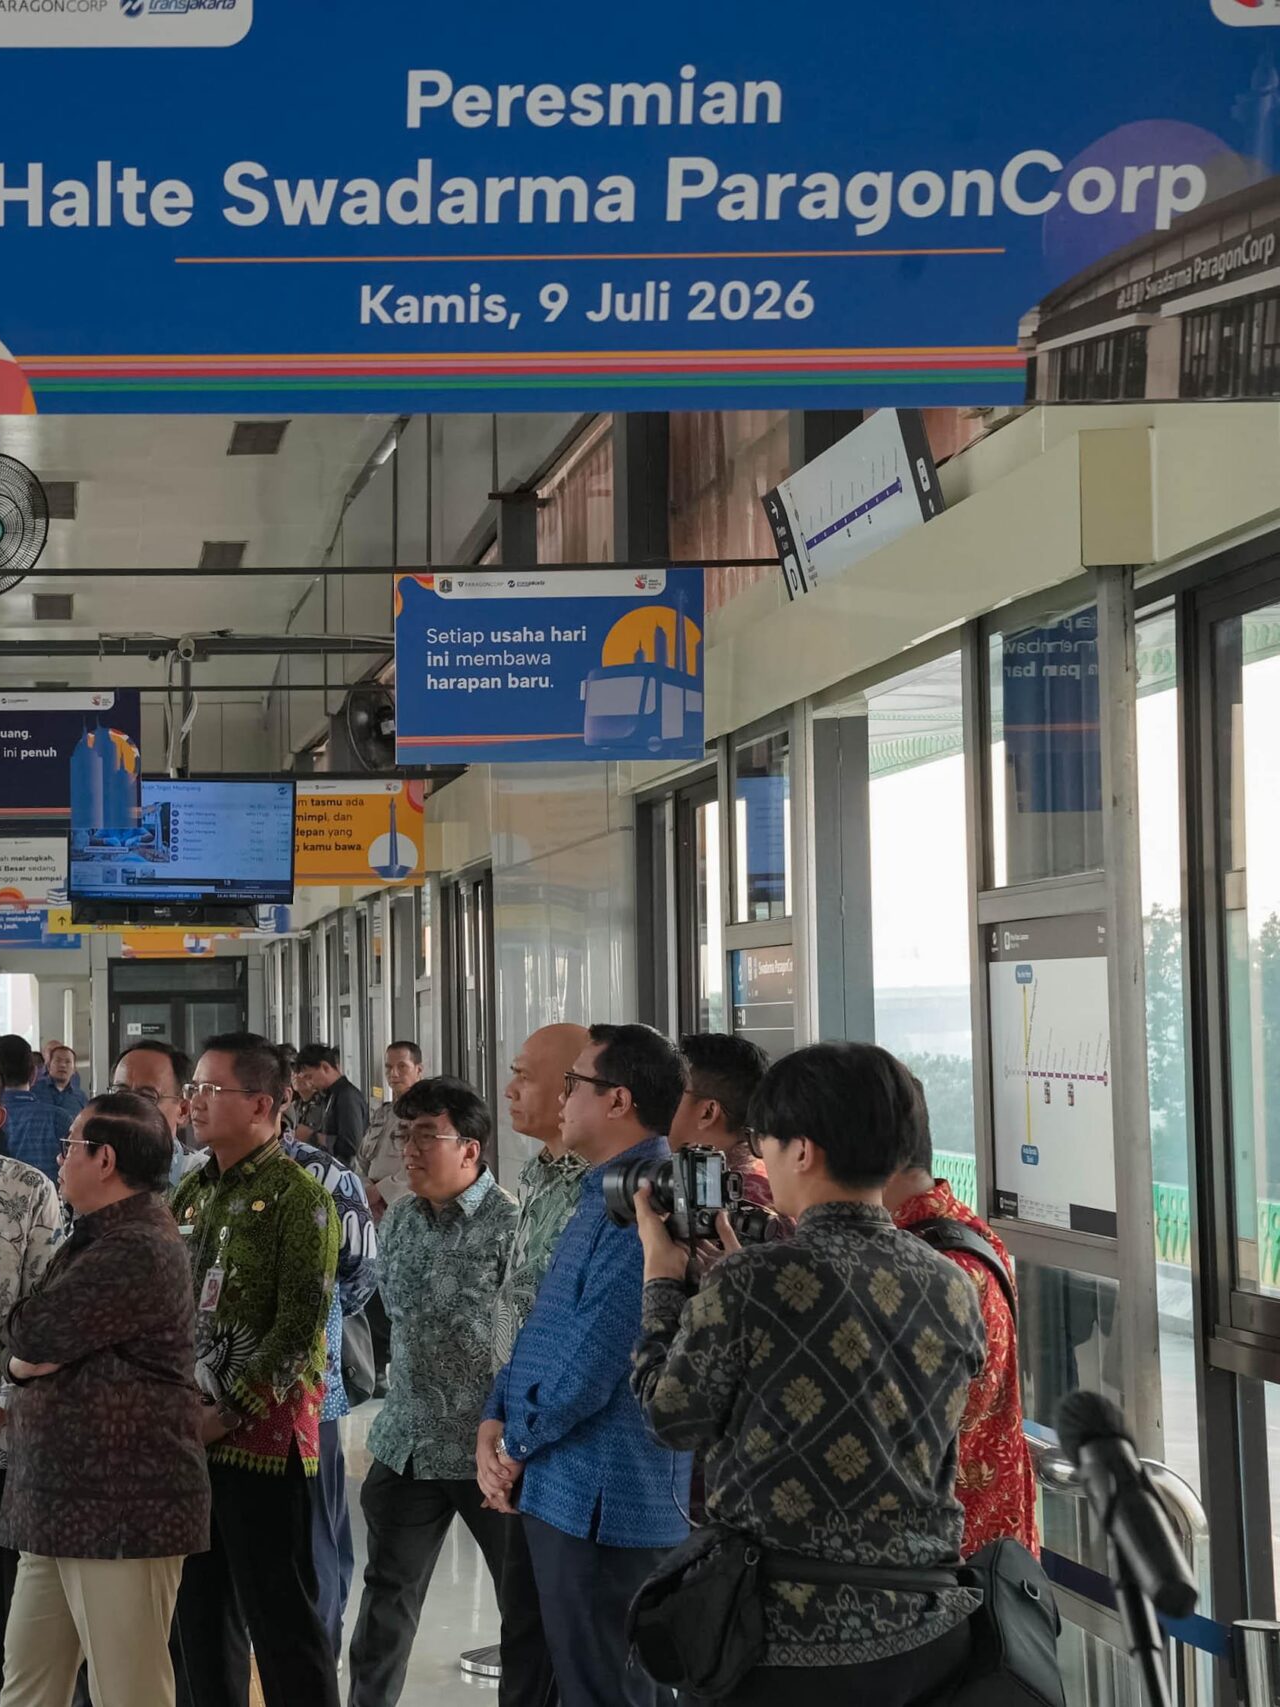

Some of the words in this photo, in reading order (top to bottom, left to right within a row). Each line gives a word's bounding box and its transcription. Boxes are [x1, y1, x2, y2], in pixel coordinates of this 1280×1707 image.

[406, 64, 783, 129] Peresmian
[222, 158, 635, 227] Swadarma
[666, 149, 1207, 237] ParagonCorp
[1193, 233, 1276, 283] ParagonCorp
[360, 283, 521, 330] Kamis,
[539, 283, 569, 323] 9
[585, 280, 671, 323] Juli
[687, 280, 816, 321] 2026
[426, 628, 484, 647] Setiap
[491, 627, 544, 643] usaha
[551, 626, 586, 642] hari
[427, 651, 449, 667] ini
[455, 650, 551, 667] membawa
[427, 674, 502, 693] harapan
[508, 673, 554, 690] baru.
[3, 747, 18, 758] ini
[21, 747, 57, 760] penuh
[311, 798, 342, 806] tasmu
[346, 798, 364, 806] ada
[333, 812, 353, 821] dan
[328, 829, 352, 838] yang
[303, 842, 331, 851] kamu
[335, 842, 366, 851] bawa.
[28, 865, 56, 873] sedang
